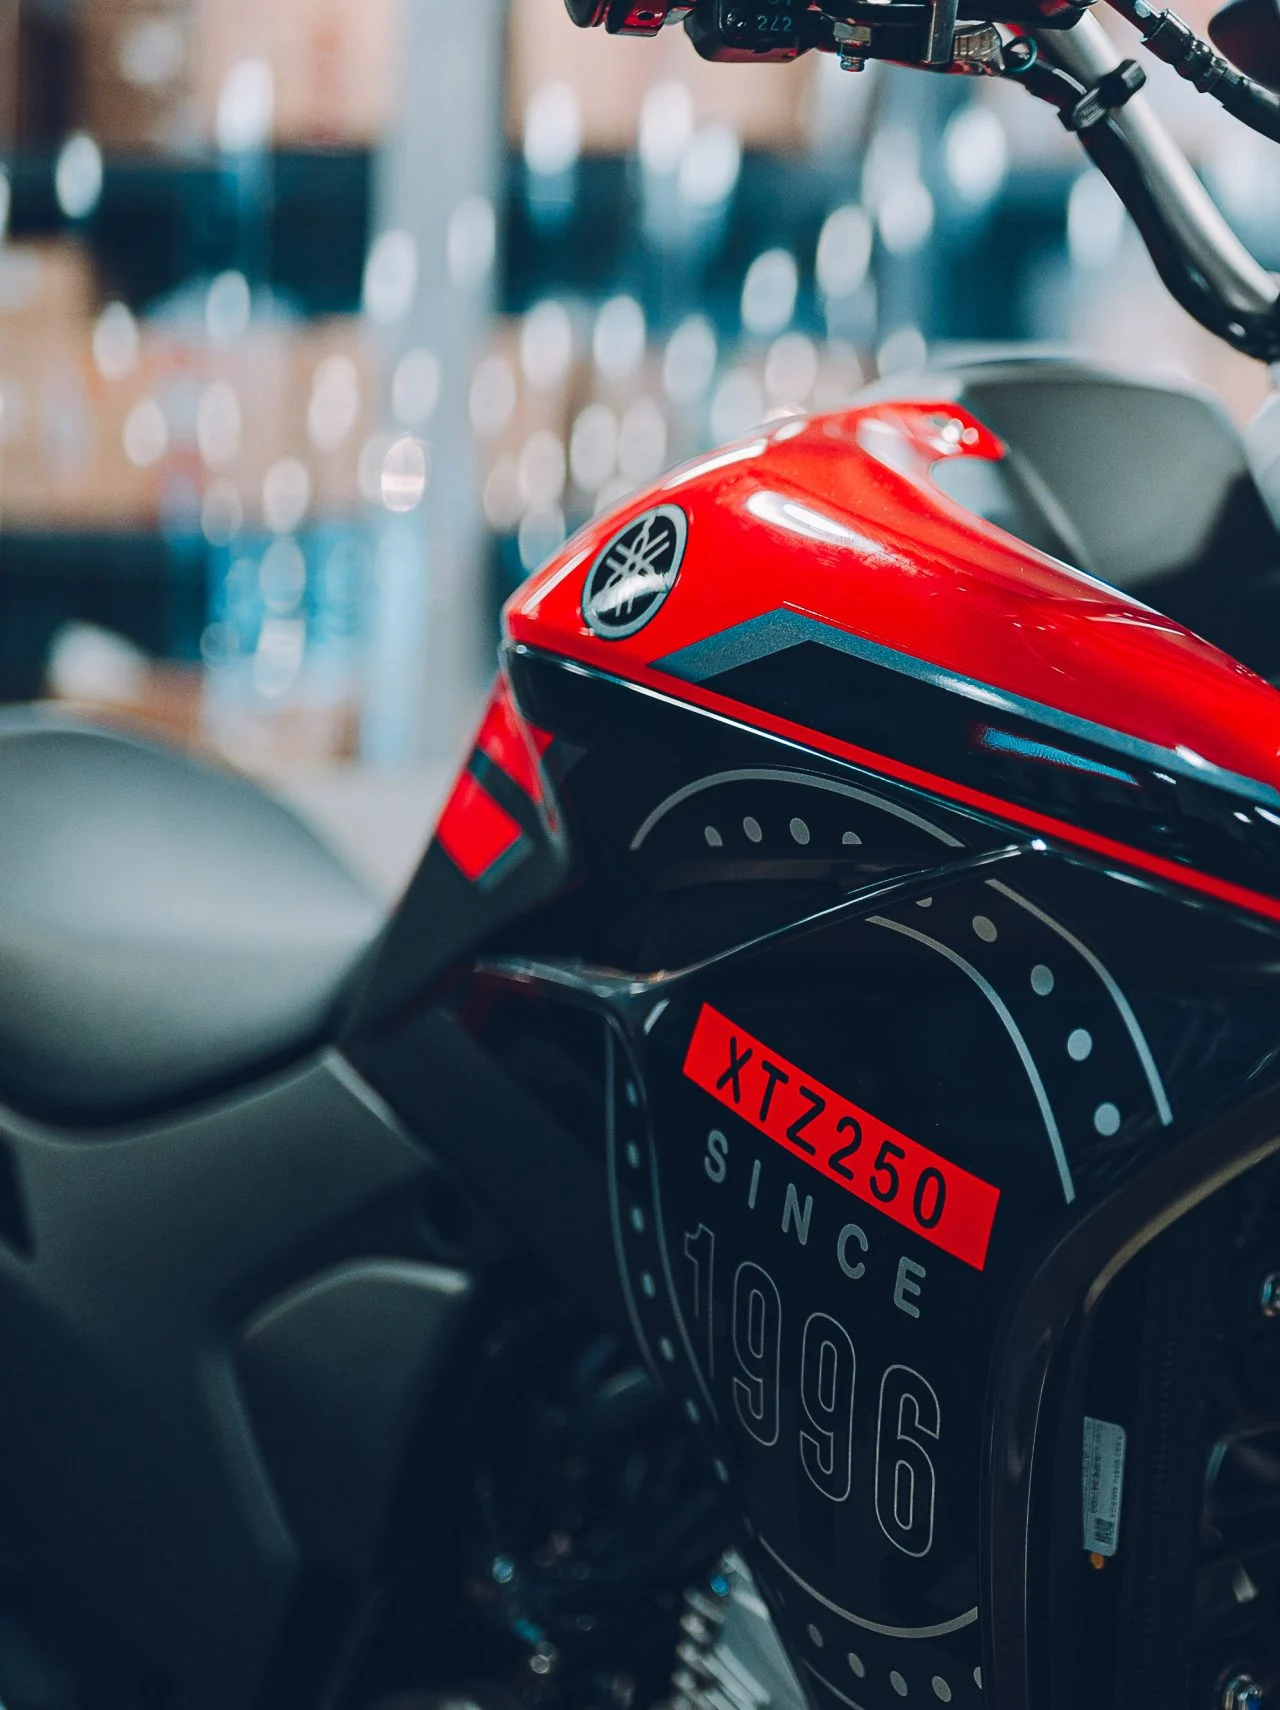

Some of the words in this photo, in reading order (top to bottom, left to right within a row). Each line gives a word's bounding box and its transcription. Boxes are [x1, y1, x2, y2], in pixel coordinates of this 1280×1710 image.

[704, 1130, 926, 1319] SINCE
[716, 1035, 947, 1230] XTZ250
[684, 1223, 941, 1558] 1996
